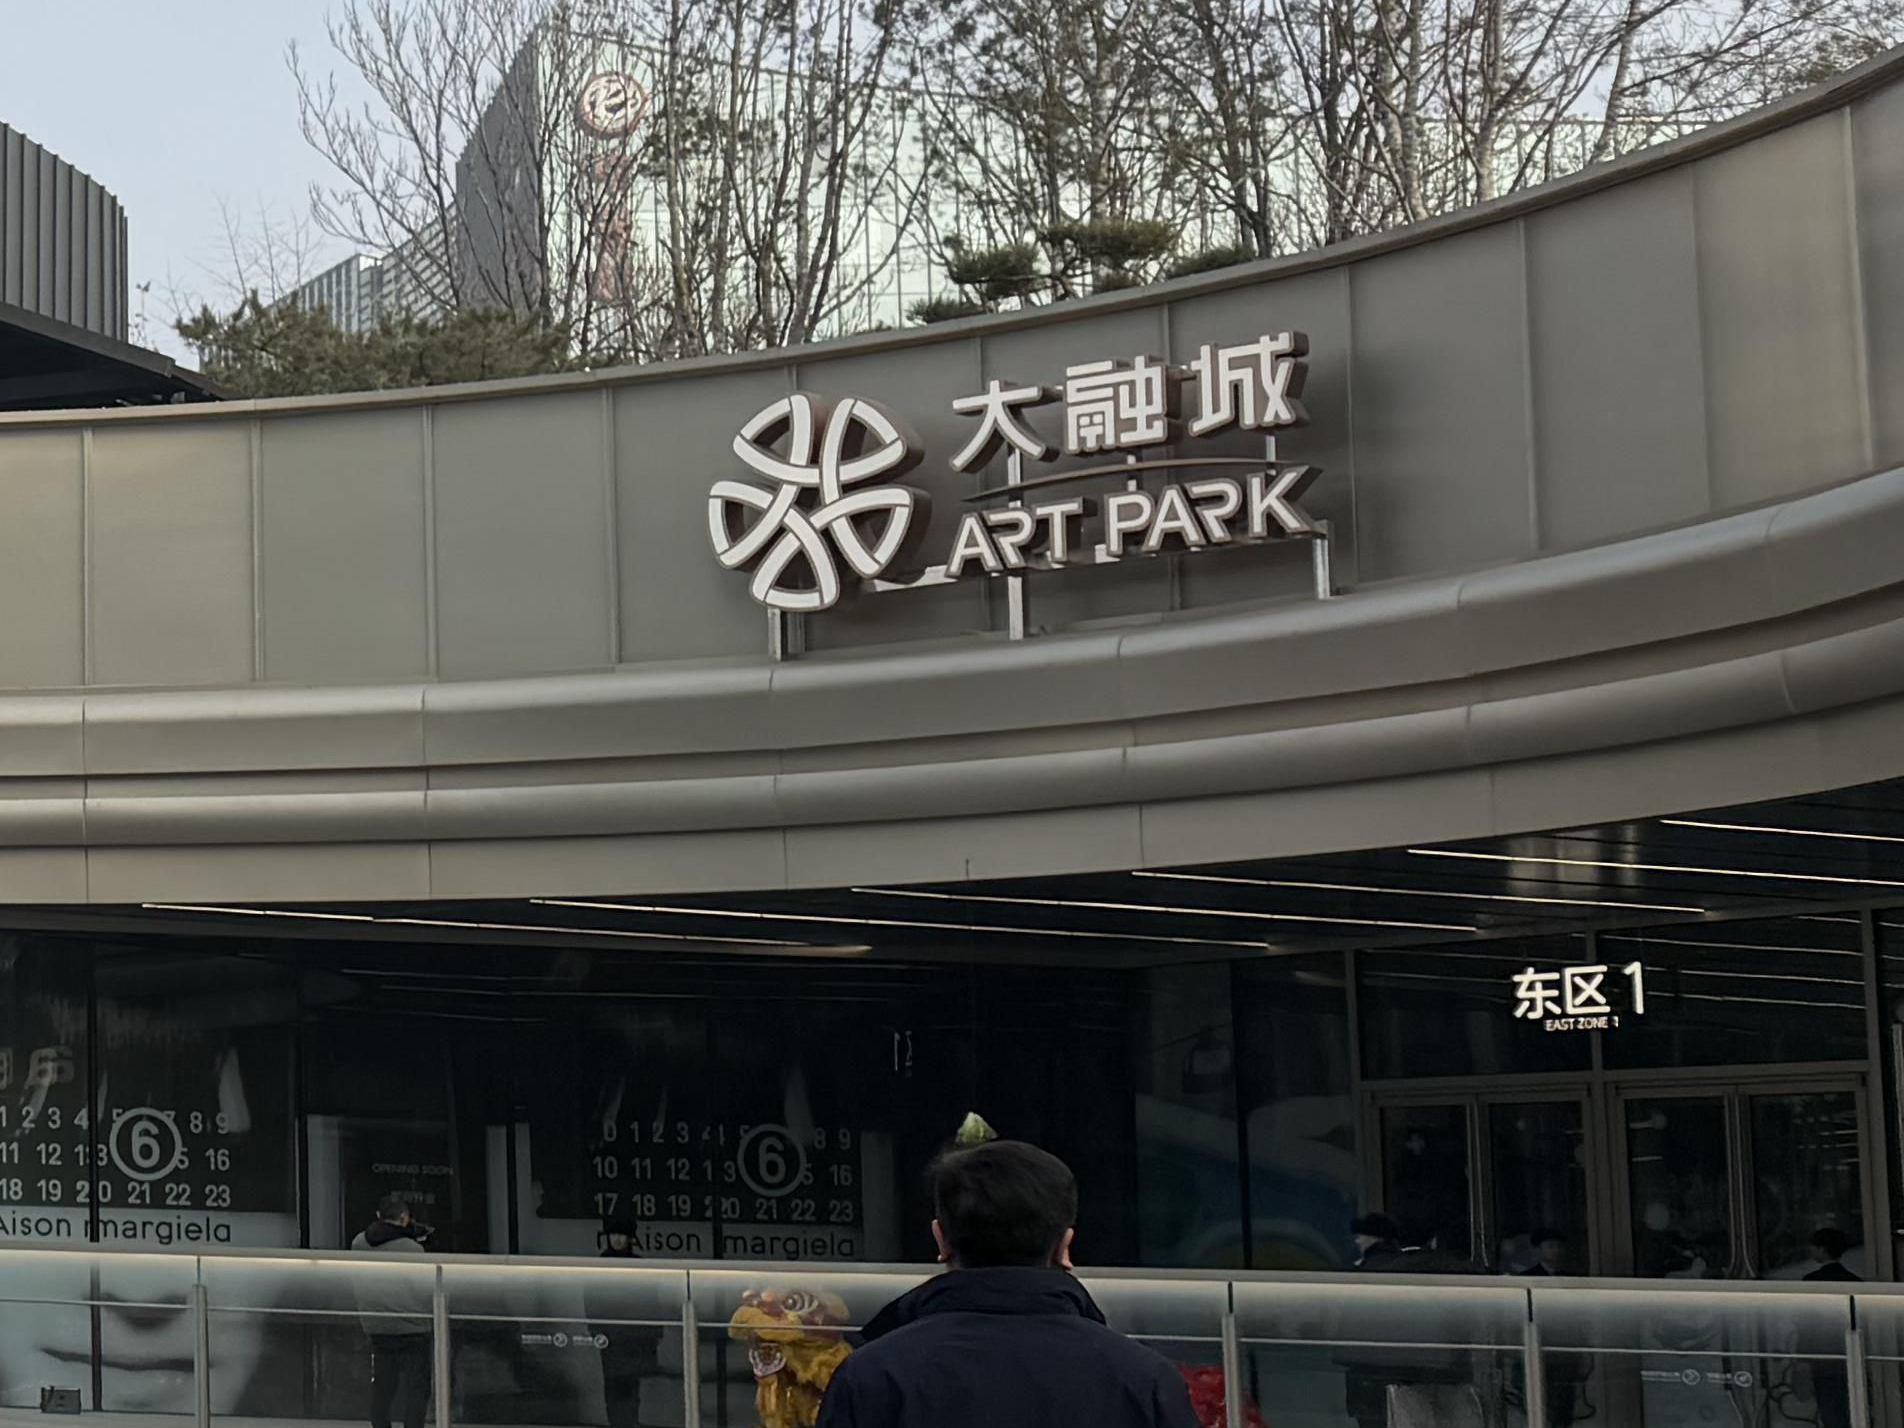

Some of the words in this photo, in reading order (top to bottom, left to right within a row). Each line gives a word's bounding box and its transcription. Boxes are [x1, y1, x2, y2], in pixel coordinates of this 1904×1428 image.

[949, 330, 1302, 473] 大融城
[944, 498, 1087, 576] ART
[1106, 466, 1315, 557] PARK
[1512, 966, 1611, 1020] 东区
[1623, 960, 1645, 1016] 1
[1543, 1018, 1575, 1032] EAST
[1576, 1016, 1609, 1030] ZONE
[22, 1106, 36, 1128] 2
[47, 1107, 61, 1129] 3
[190, 1111, 203, 1134] 8
[215, 1112, 229, 1134] 9
[630, 1121, 640, 1144] 1
[652, 1122, 665, 1144] 2
[675, 1121, 690, 1144] 3
[814, 1127, 827, 1149] 8
[838, 1127, 851, 1150] 9
[36, 1142, 62, 1166] 12
[205, 1148, 231, 1171] 16
[130, 1119, 161, 1168] 6
[592, 1155, 619, 1179] 10
[631, 1156, 653, 1180] 11
[665, 1157, 691, 1180] 12
[829, 1164, 853, 1187] 16
[757, 1136, 787, 1184] 6
[37, 1180, 62, 1203] 19
[127, 1182, 151, 1205] 21
[164, 1183, 192, 1206] 22
[204, 1184, 231, 1208] 23
[593, 1192, 619, 1216] 17
[631, 1193, 656, 1217] 18
[666, 1194, 692, 1218] 19
[755, 1197, 778, 1220] 21
[790, 1198, 816, 1222] 22
[829, 1199, 854, 1223] 23
[723, 1232, 855, 1260] margiela
